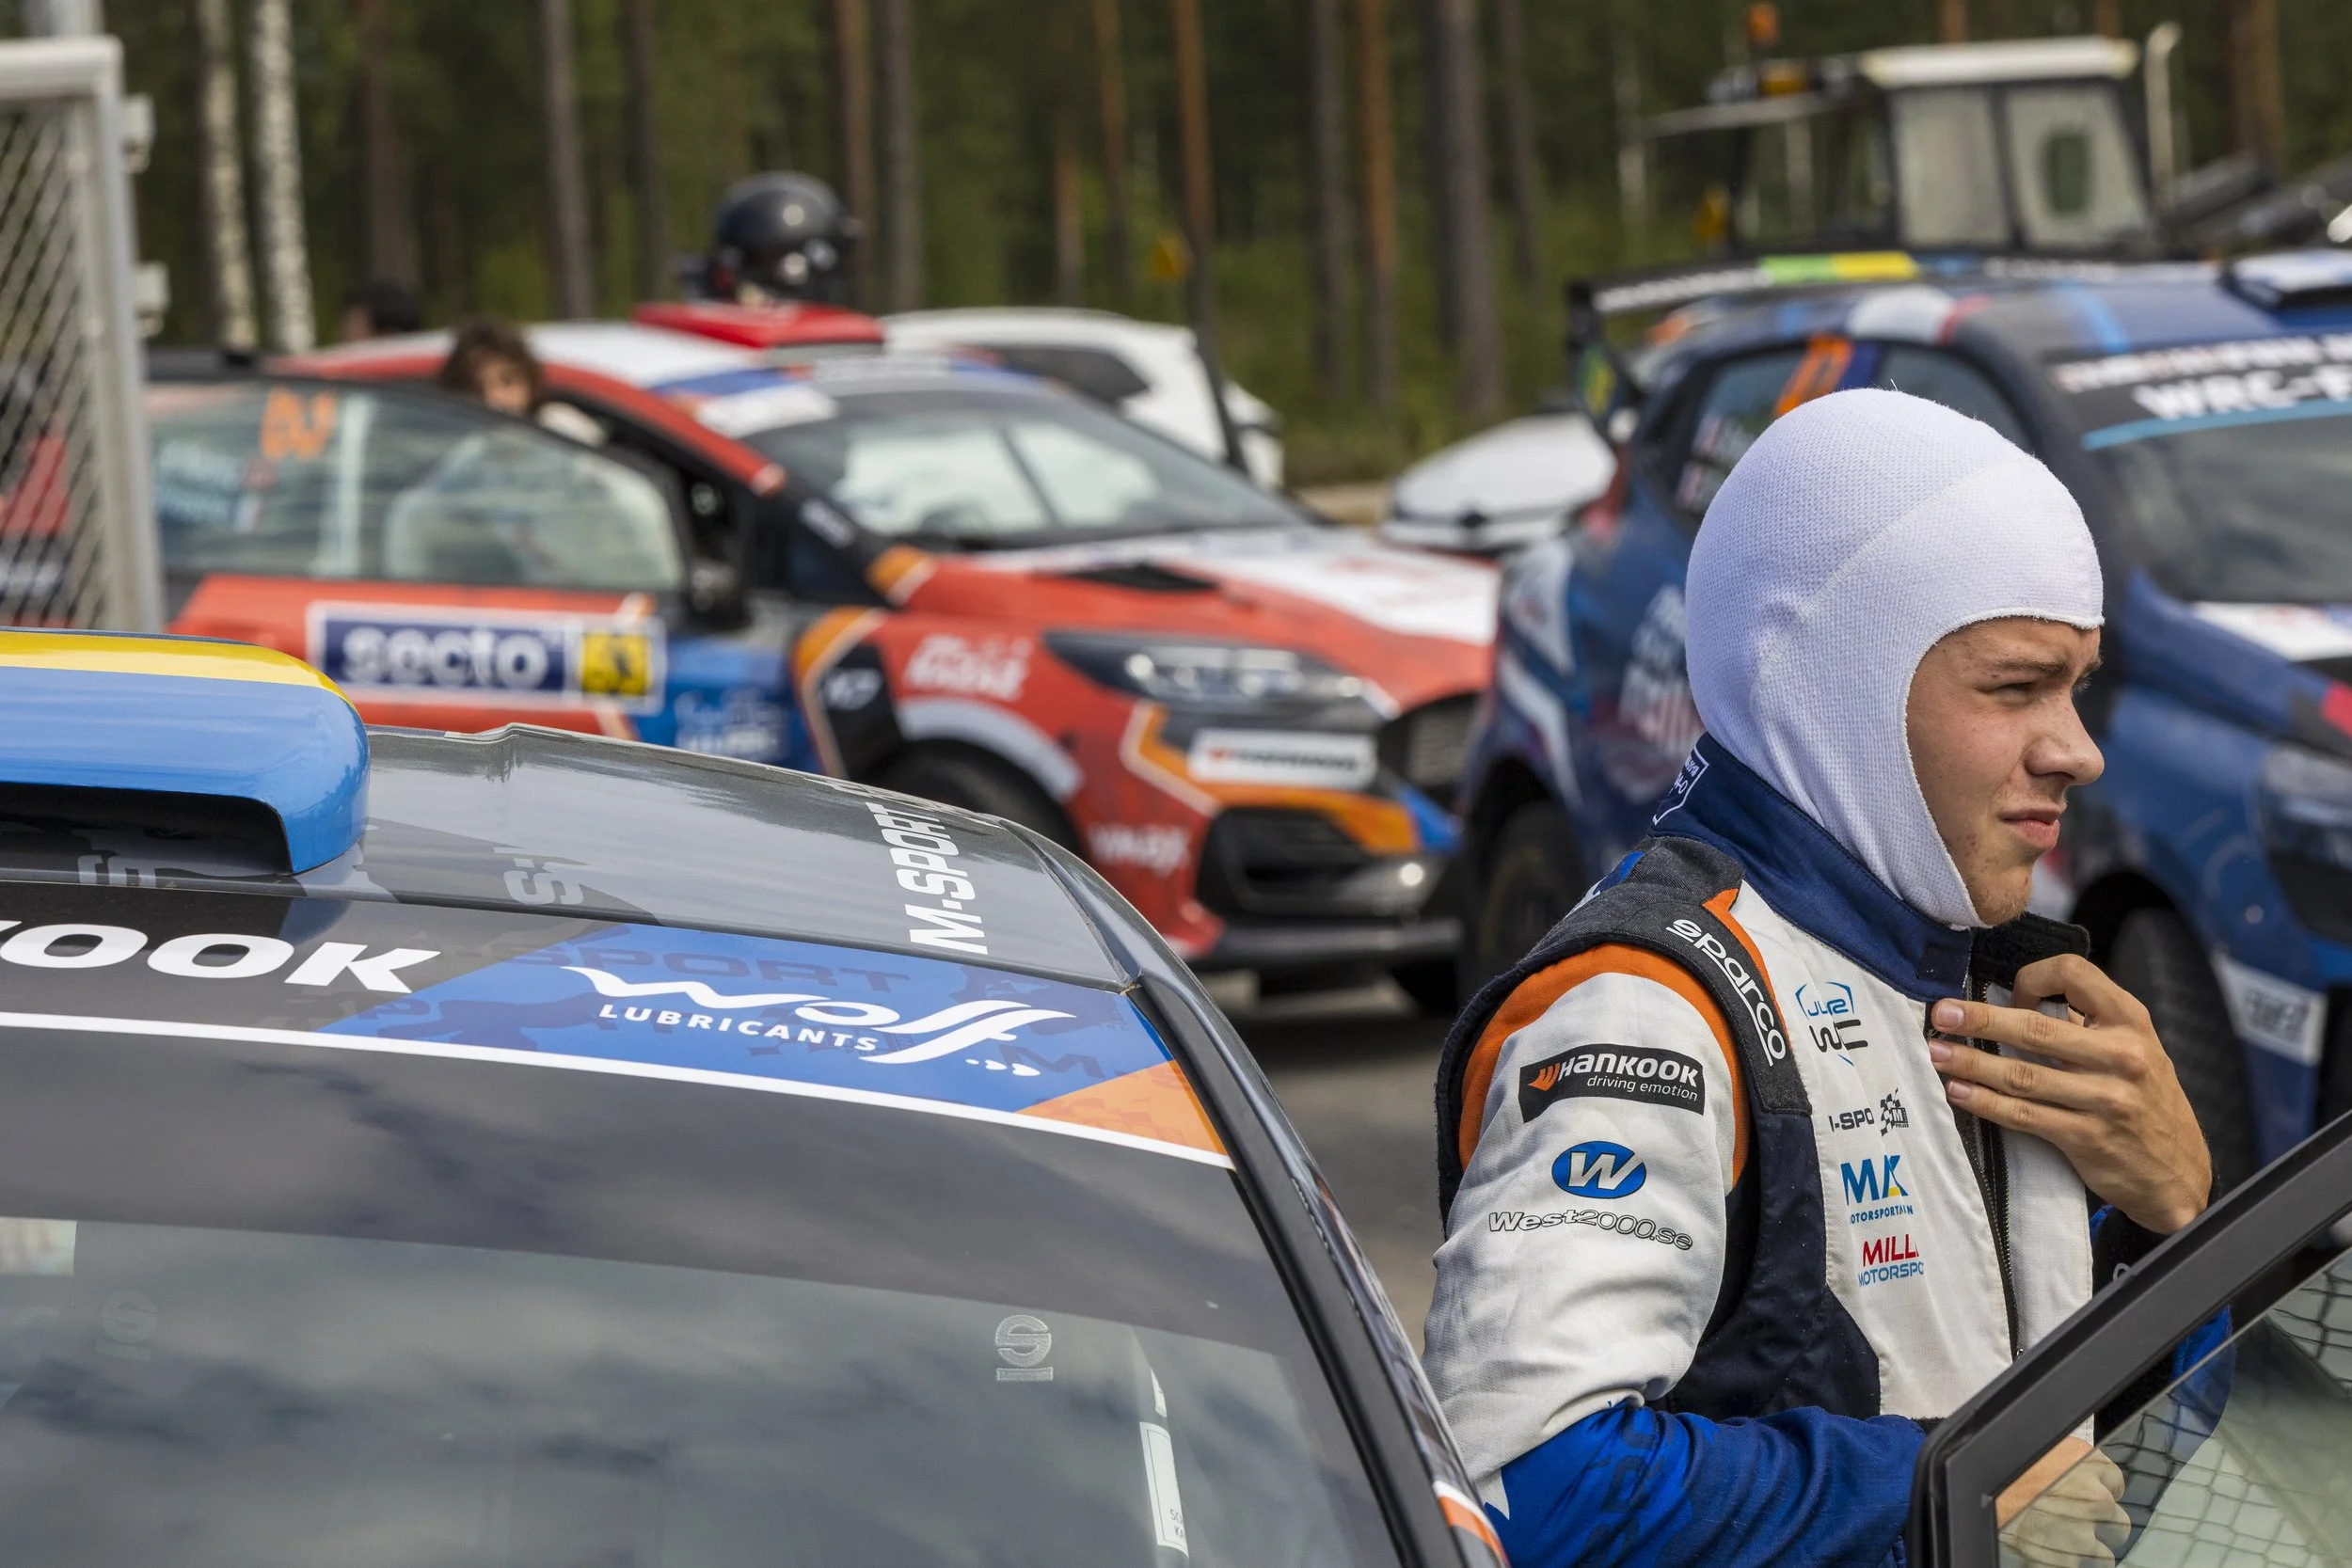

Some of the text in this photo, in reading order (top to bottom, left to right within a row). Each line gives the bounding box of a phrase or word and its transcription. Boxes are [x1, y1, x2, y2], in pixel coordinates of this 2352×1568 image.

[341, 626, 548, 689] secto
[865, 801, 988, 955] M-SPORT
[0, 920, 442, 994] OOK
[1665, 919, 1787, 1067] sparco
[598, 1004, 880, 1053] LUBRICANTS
[1586, 1075, 1698, 1102] driving emotion
[1567, 1150, 1644, 1191] W
[1488, 1209, 1693, 1251] West2000.se
[1863, 1233, 1920, 1268] MILL
